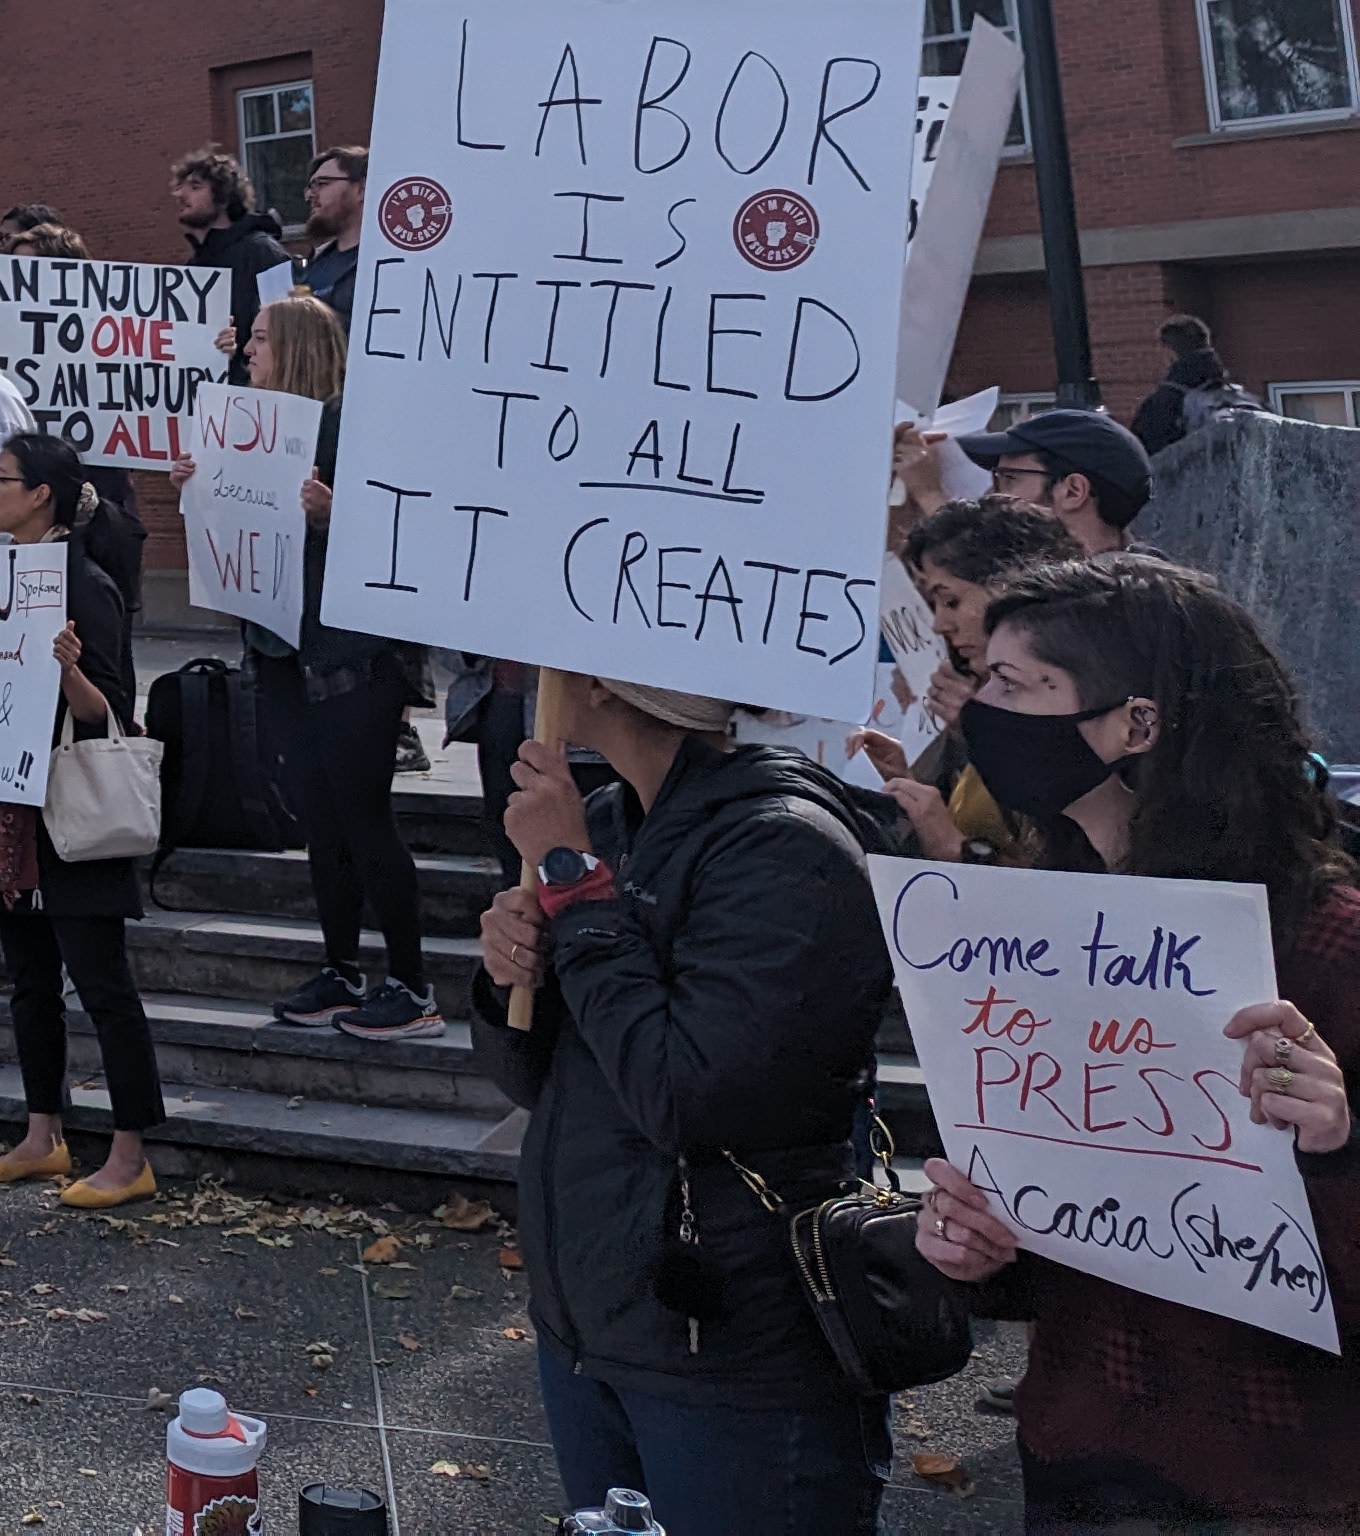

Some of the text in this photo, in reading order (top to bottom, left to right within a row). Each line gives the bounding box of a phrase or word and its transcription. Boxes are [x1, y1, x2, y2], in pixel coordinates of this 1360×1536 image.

[455, 17, 881, 192] LABOR
[391, 185, 437, 205] I'M WITH
[757, 199, 807, 226] I'M WITH
[553, 191, 697, 269] IS
[49, 261, 222, 324] INJURY
[20, 310, 176, 361] TO ONE
[364, 256, 862, 402] ENTITLED
[49, 363, 90, 408] AN
[30, 409, 95, 454] TO
[198, 393, 278, 454] WSU
[471, 387, 765, 497] TO ALL
[18, 572, 62, 618] Spokane
[205, 528, 261, 594] WE
[364, 480, 877, 665] IT CREATES
[893, 870, 1218, 997] Come talk
[960, 985, 1177, 1055] to us
[973, 1046, 1243, 1152] PRESS
[967, 1144, 1326, 1313] Acacia (she/her)
